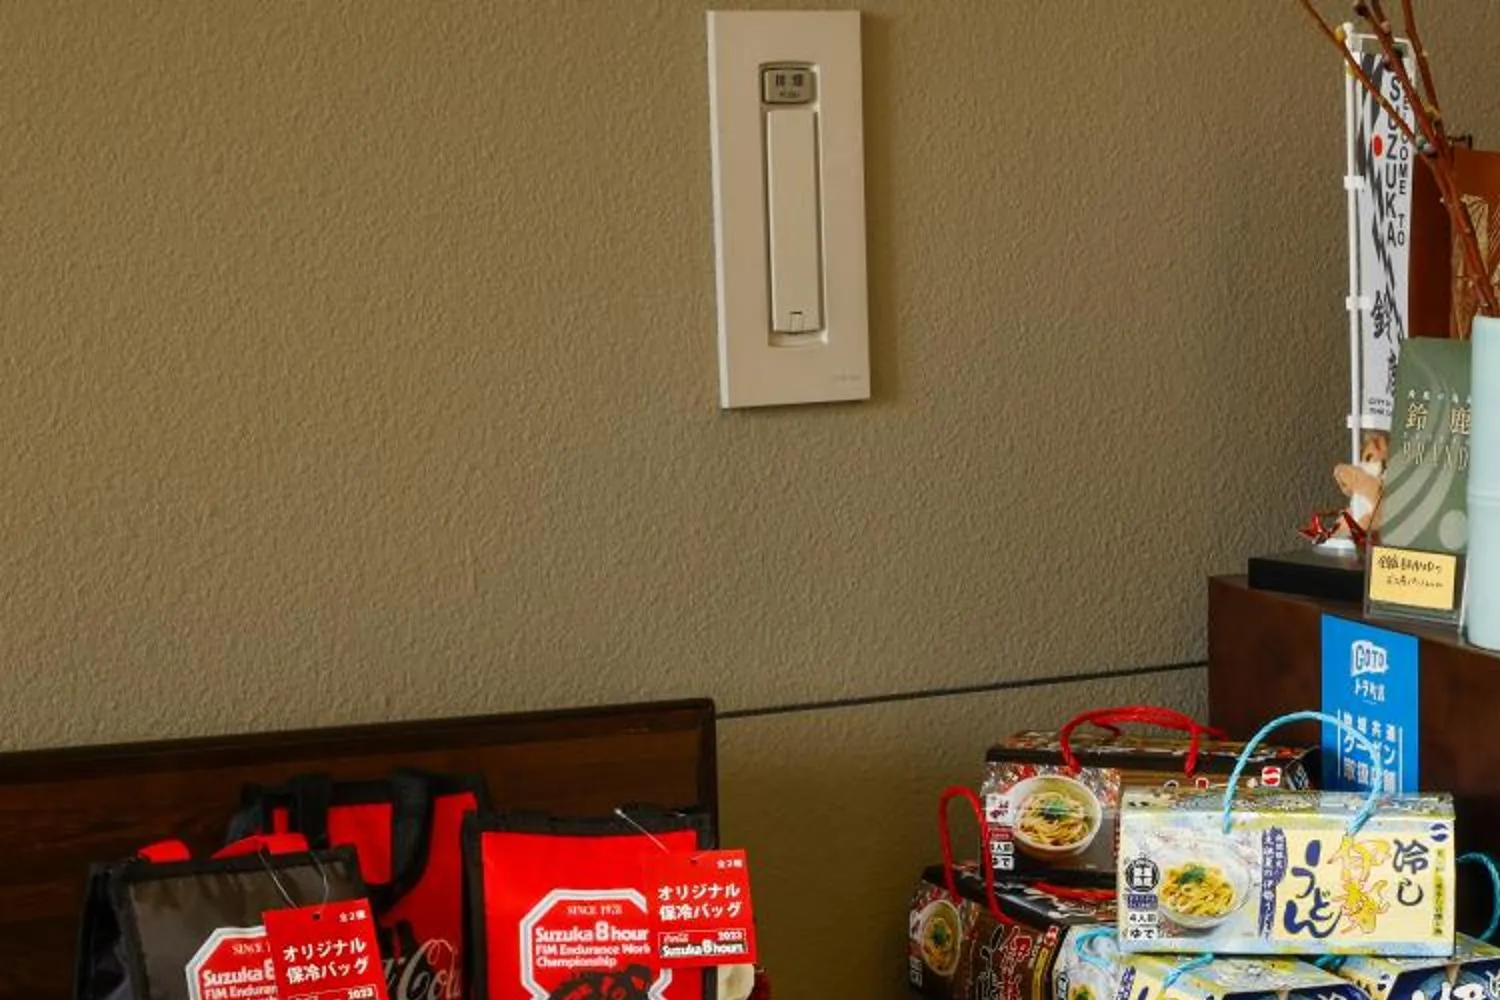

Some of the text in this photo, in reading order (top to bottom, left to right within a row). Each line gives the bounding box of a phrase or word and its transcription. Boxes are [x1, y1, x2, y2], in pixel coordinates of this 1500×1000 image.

[657, 882, 741, 901] オリジナル
[658, 900, 743, 922] 保冷バッグ
[535, 920, 649, 943] Suzuka 8 hour
[283, 936, 367, 963] オリジナル
[536, 945, 558, 957] FIM
[559, 944, 620, 957] Endurance
[661, 943, 703, 957] Suzuka
[712, 940, 745, 954] hours
[286, 955, 369, 985] 保冷バッグ
[536, 956, 618, 969] Championship
[202, 963, 263, 987] Suzuka
[229, 983, 279, 997] Enduran
